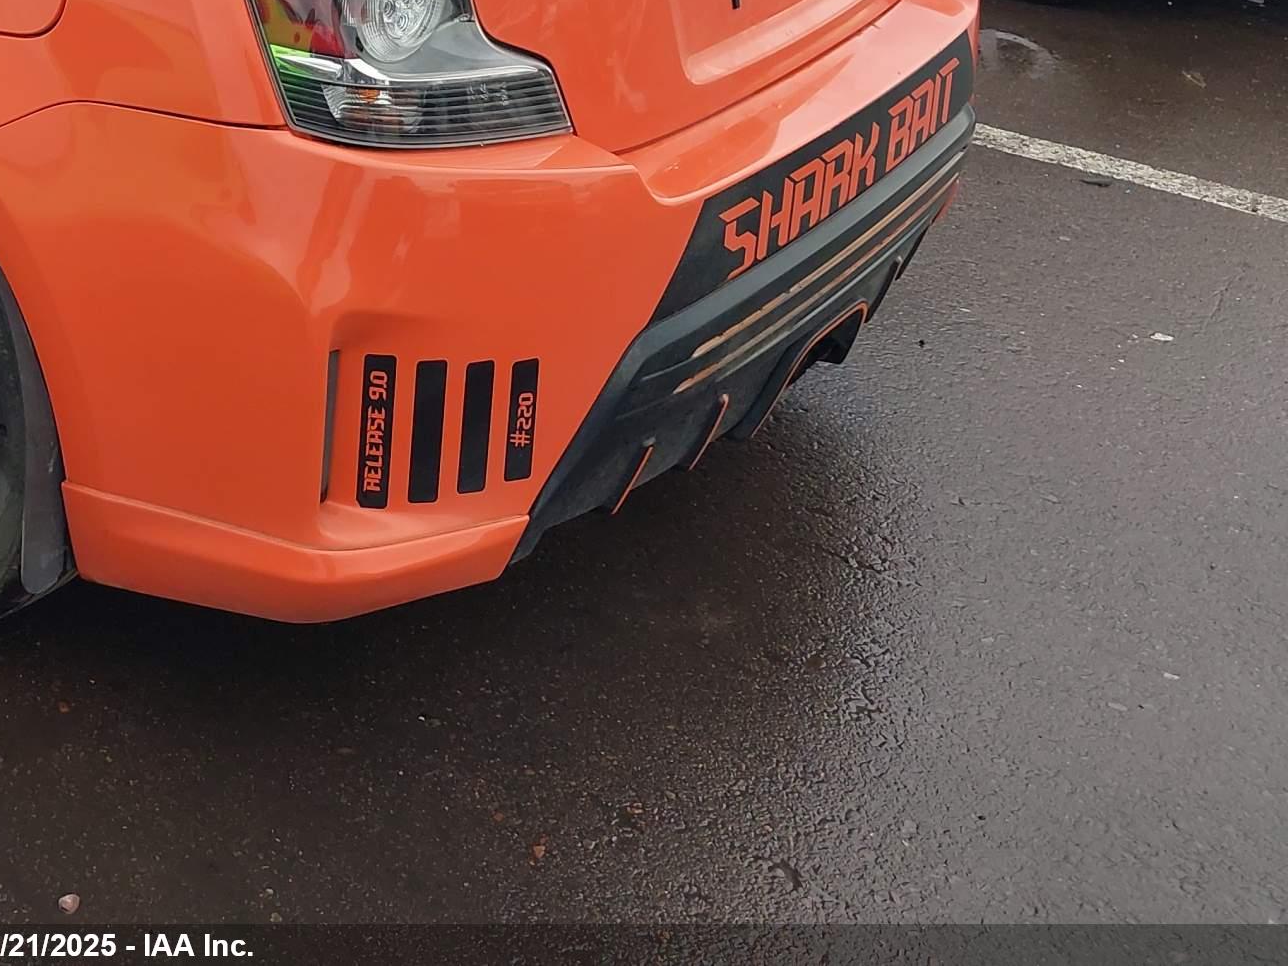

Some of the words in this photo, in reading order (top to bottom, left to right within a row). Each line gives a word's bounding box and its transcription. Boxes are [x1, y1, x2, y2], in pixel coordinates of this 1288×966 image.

[718, 121, 880, 281] SHARK
[885, 57, 960, 173] BAIT
[368, 370, 388, 402] 9.0
[509, 392, 533, 448] #220
[363, 405, 386, 493] RELEASE
